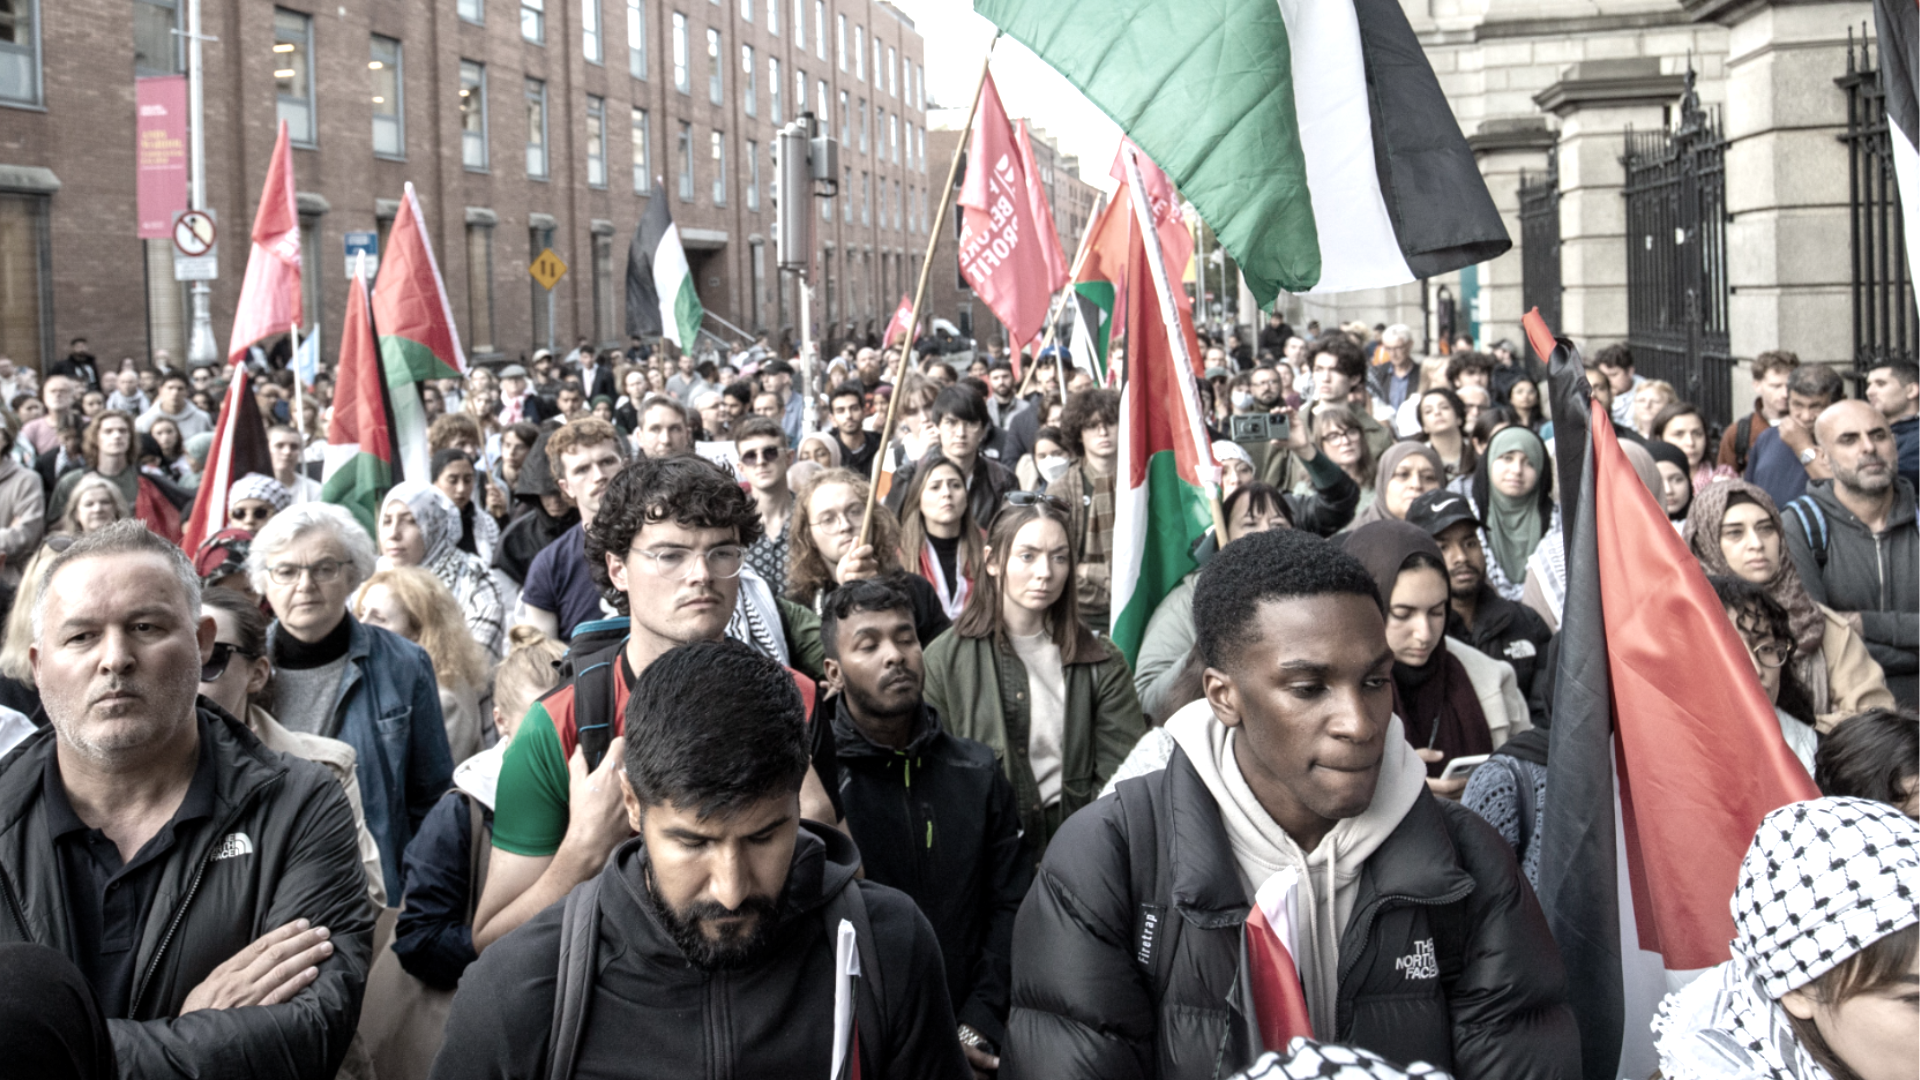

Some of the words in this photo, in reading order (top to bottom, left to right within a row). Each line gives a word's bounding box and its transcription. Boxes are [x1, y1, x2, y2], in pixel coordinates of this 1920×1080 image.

[1138, 913, 1158, 965] Firetrap
[1413, 937, 1435, 955] THE
[1395, 952, 1437, 970] NORTH
[1405, 966, 1438, 980] FACE
